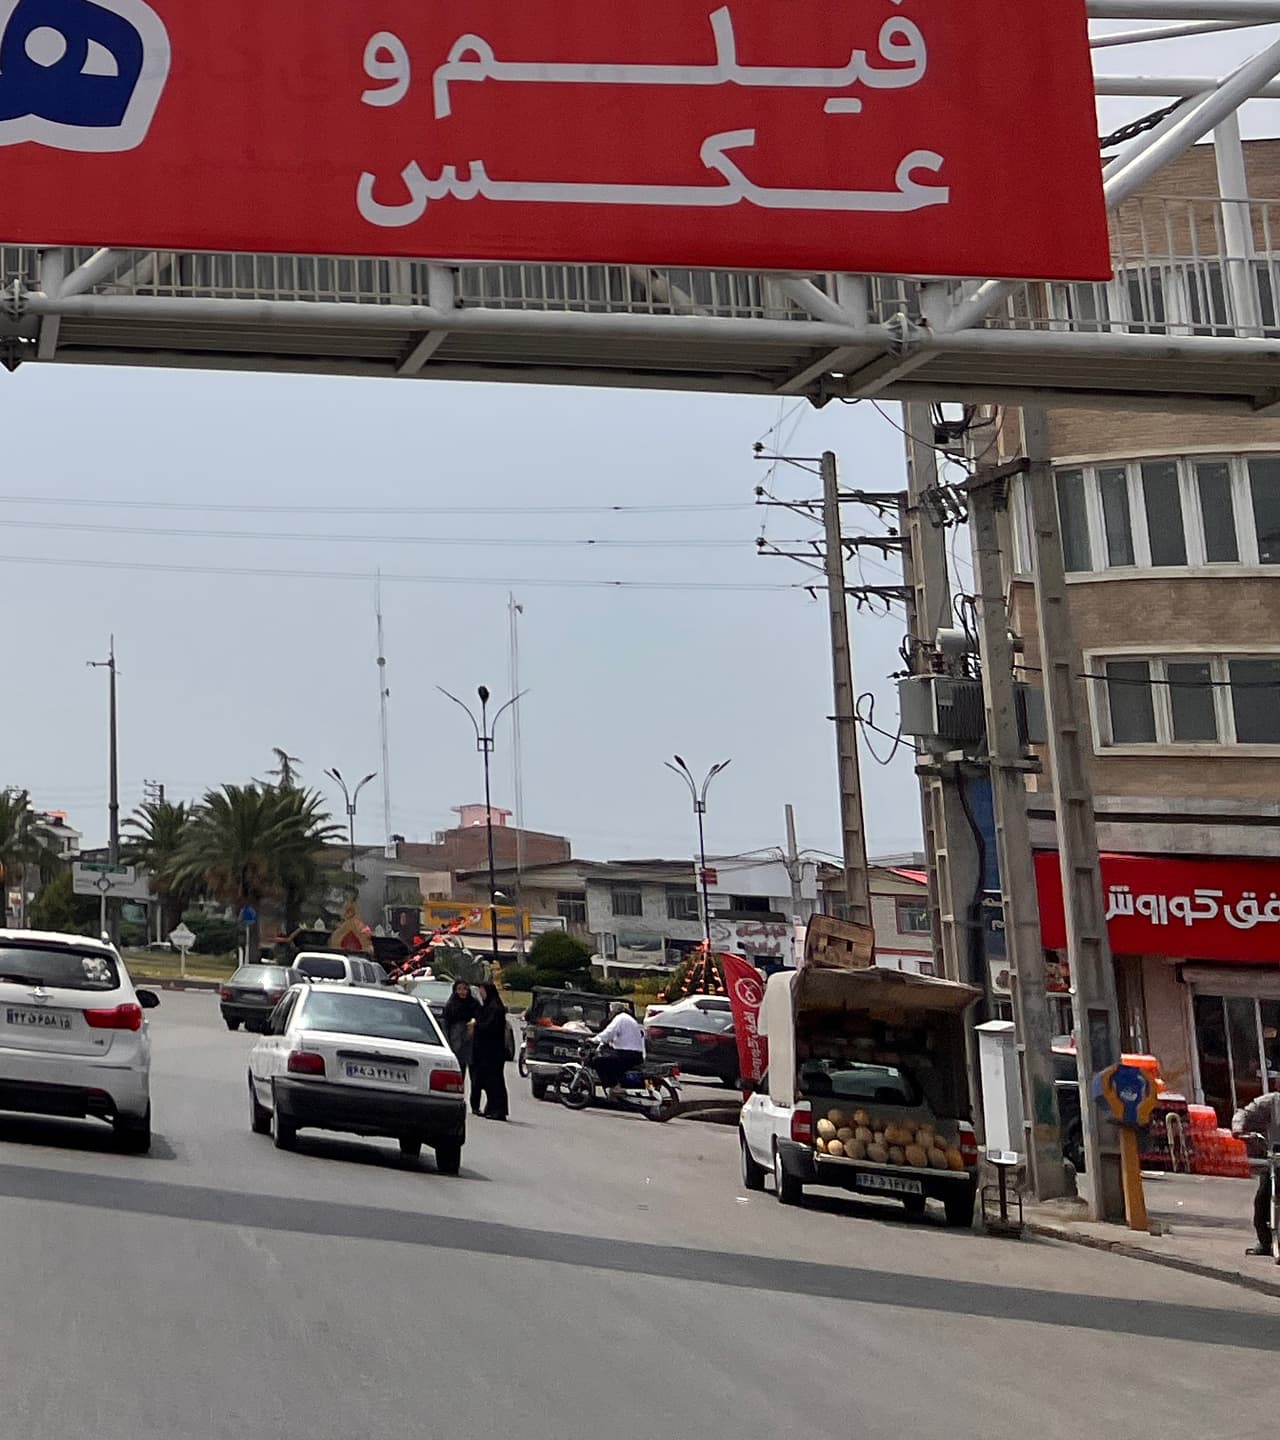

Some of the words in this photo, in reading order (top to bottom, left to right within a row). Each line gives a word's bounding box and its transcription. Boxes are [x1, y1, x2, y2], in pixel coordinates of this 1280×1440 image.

[360, 30, 411, 108] و
[356, 128, 950, 227] عکس
[1105, 885, 1223, 926] کوروش
